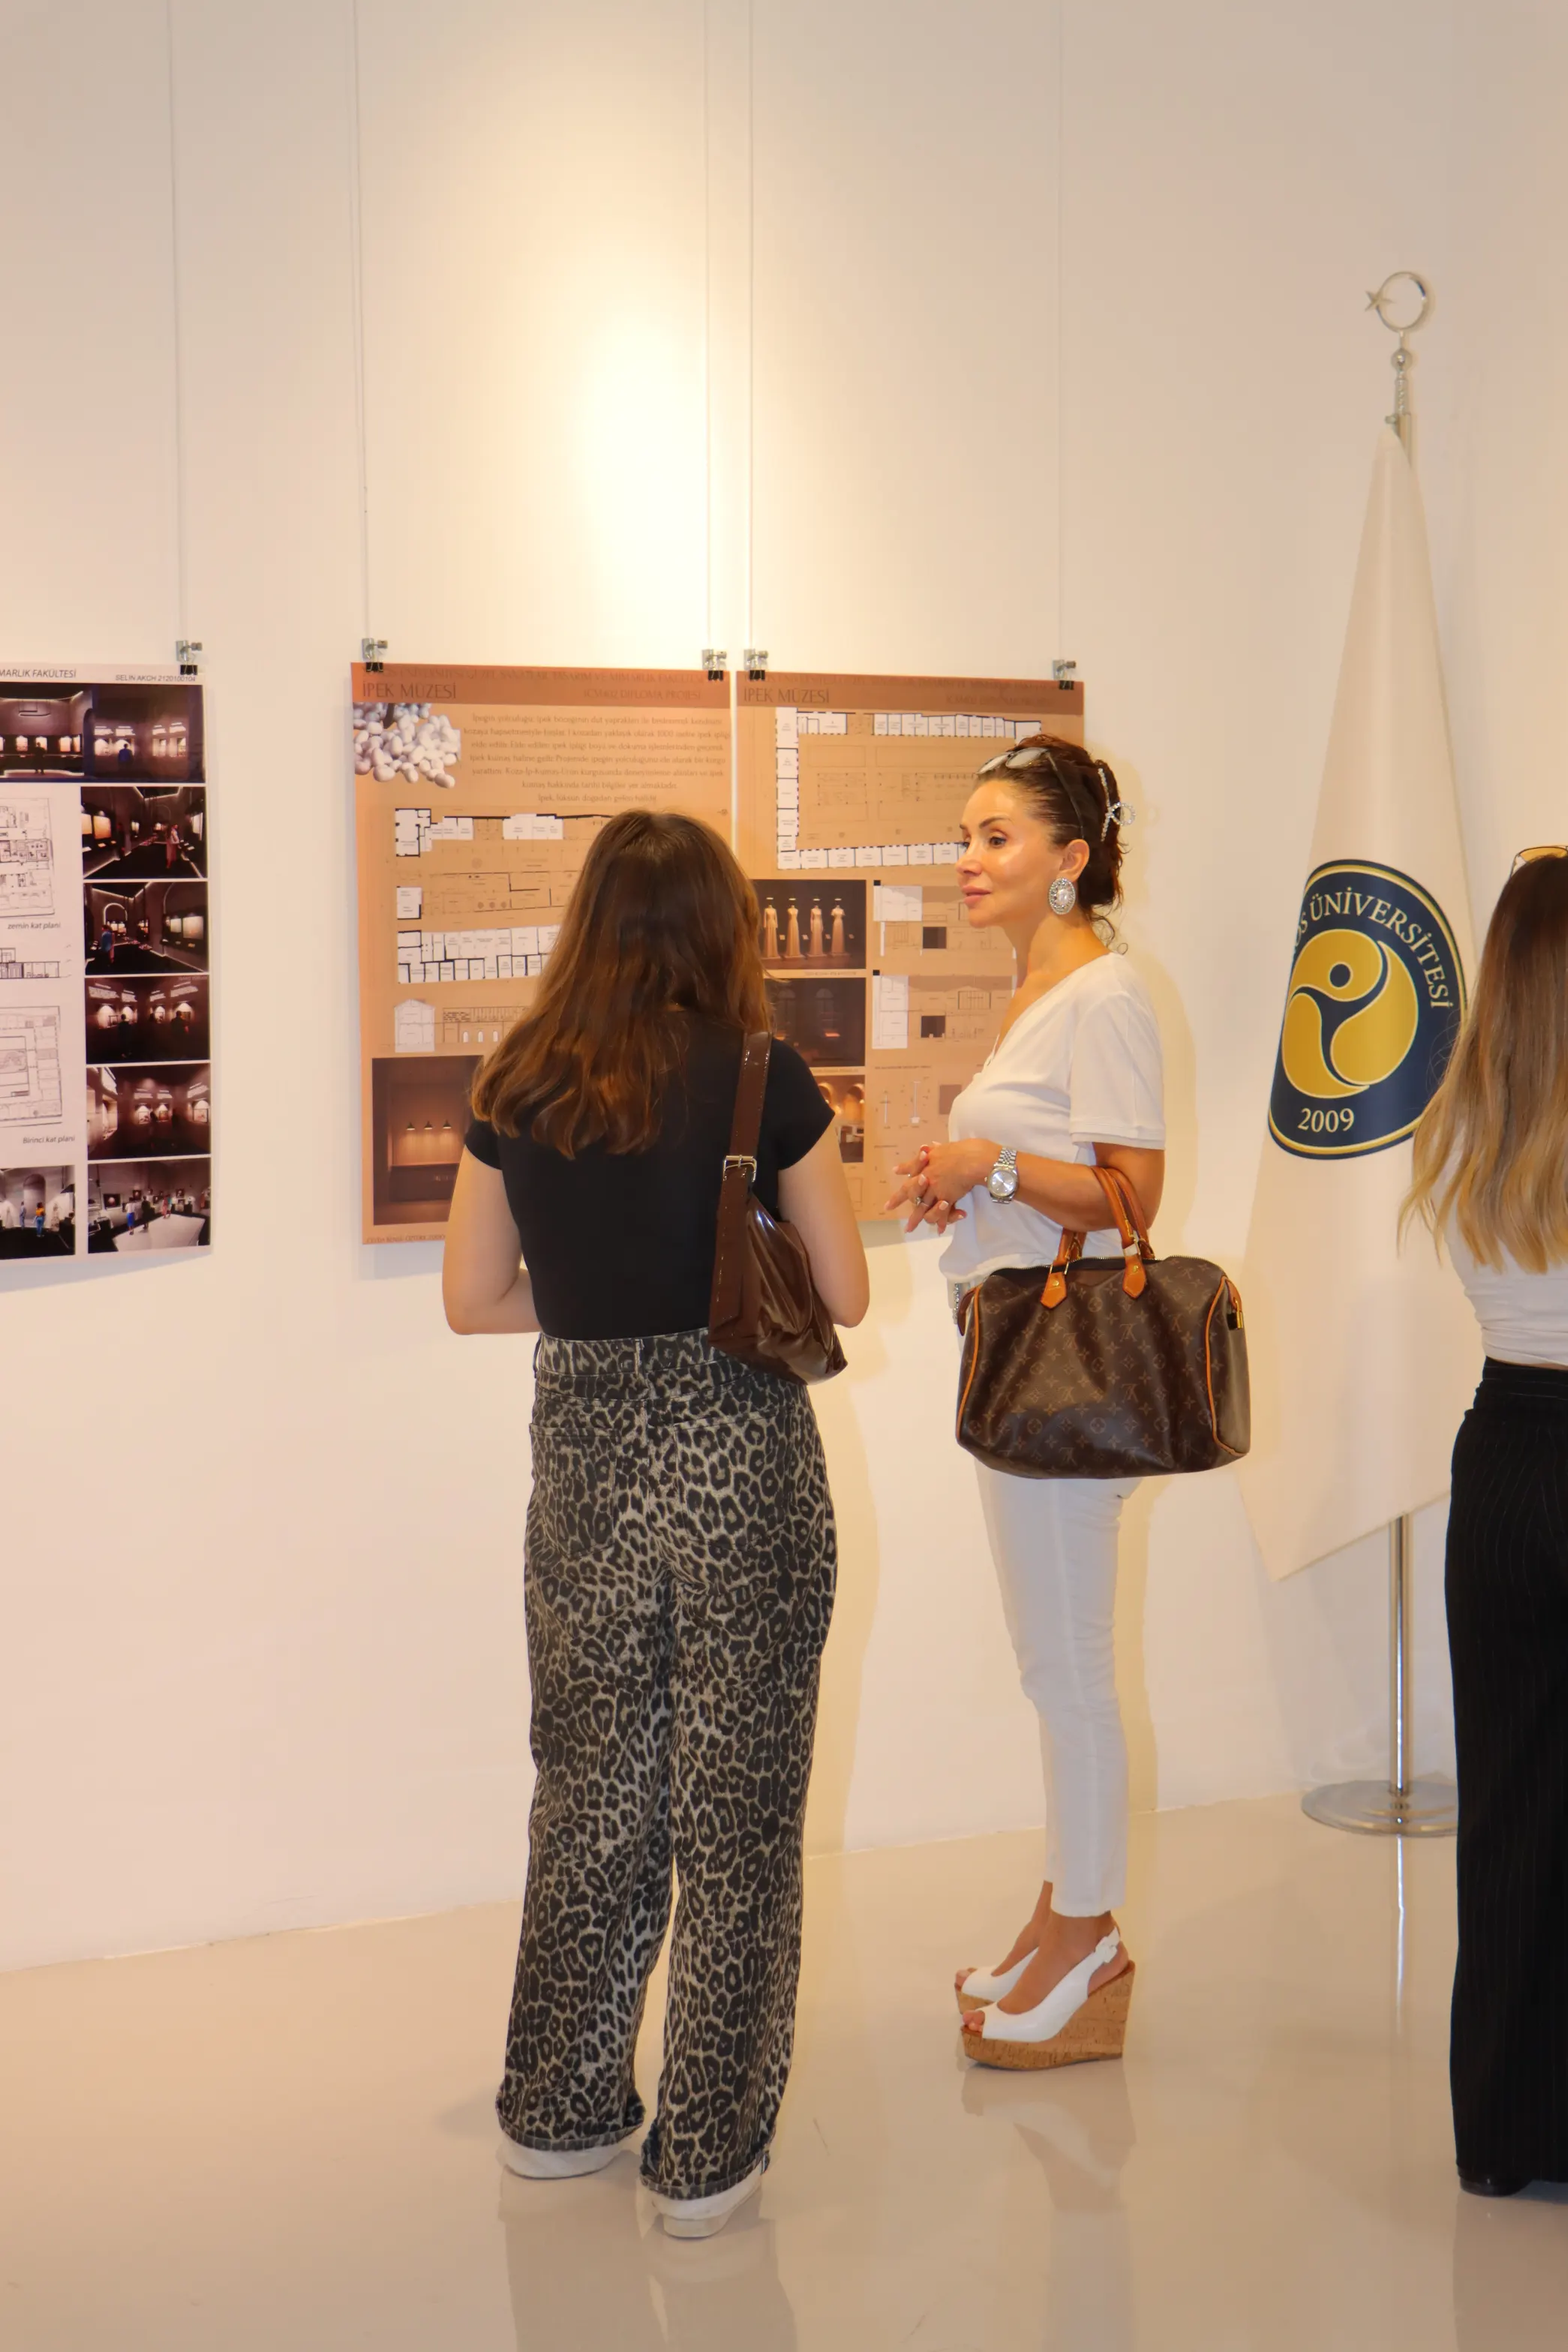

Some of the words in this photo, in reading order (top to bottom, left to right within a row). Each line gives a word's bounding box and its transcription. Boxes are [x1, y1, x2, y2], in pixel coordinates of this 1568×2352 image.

[362, 680, 395, 698] İPEK
[400, 681, 457, 699] MÜZESİ
[743, 686, 773, 703] İPEK
[777, 688, 830, 704] MÜZESİ
[1309, 887, 1453, 1008] ÜNİVERSİTESİ
[1297, 1107, 1354, 1133] 2009
